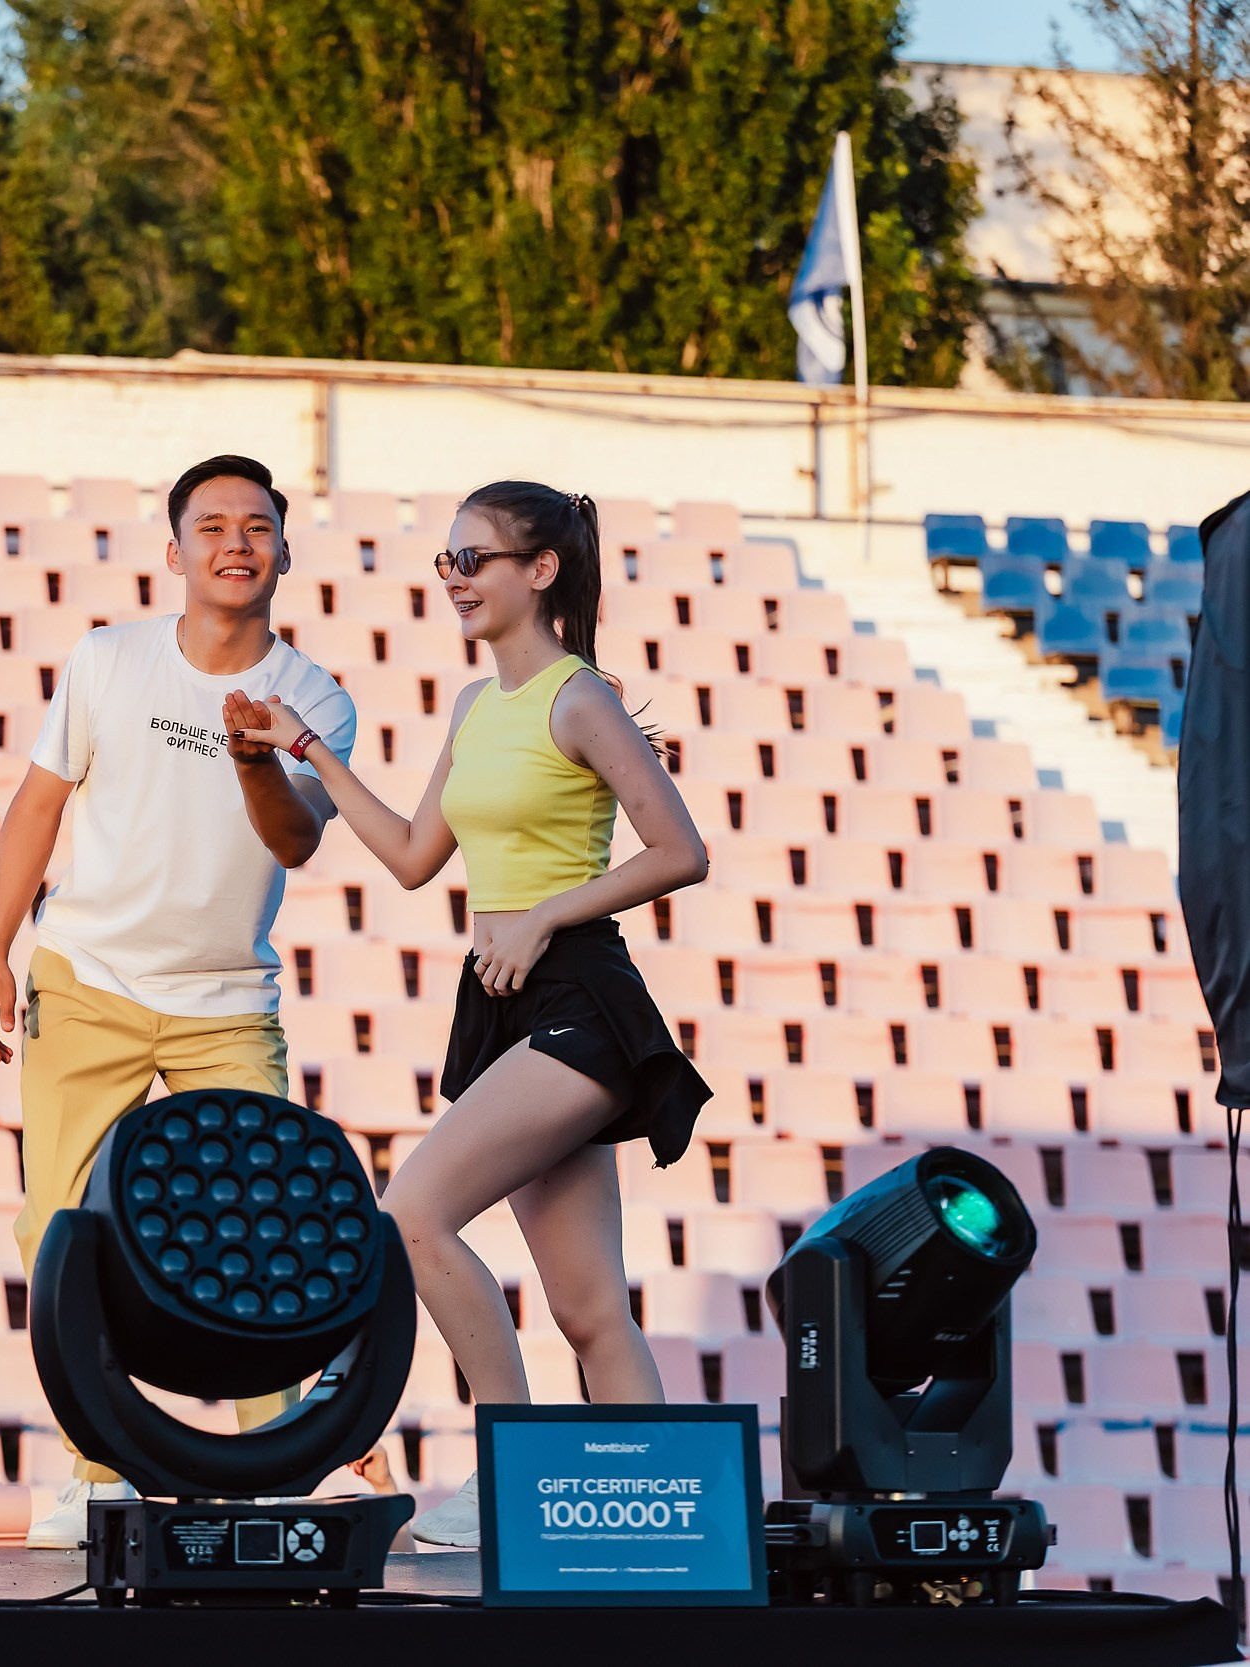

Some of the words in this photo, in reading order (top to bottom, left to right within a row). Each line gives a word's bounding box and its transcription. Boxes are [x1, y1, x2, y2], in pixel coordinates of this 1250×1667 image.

[150, 717, 208, 741] БОЛЬШЕ
[212, 732, 229, 747] ЧЕ
[166, 736, 219, 758] ФИТНЕС
[537, 1478, 581, 1494] GIFT
[582, 1478, 702, 1494] CERTIFICATE
